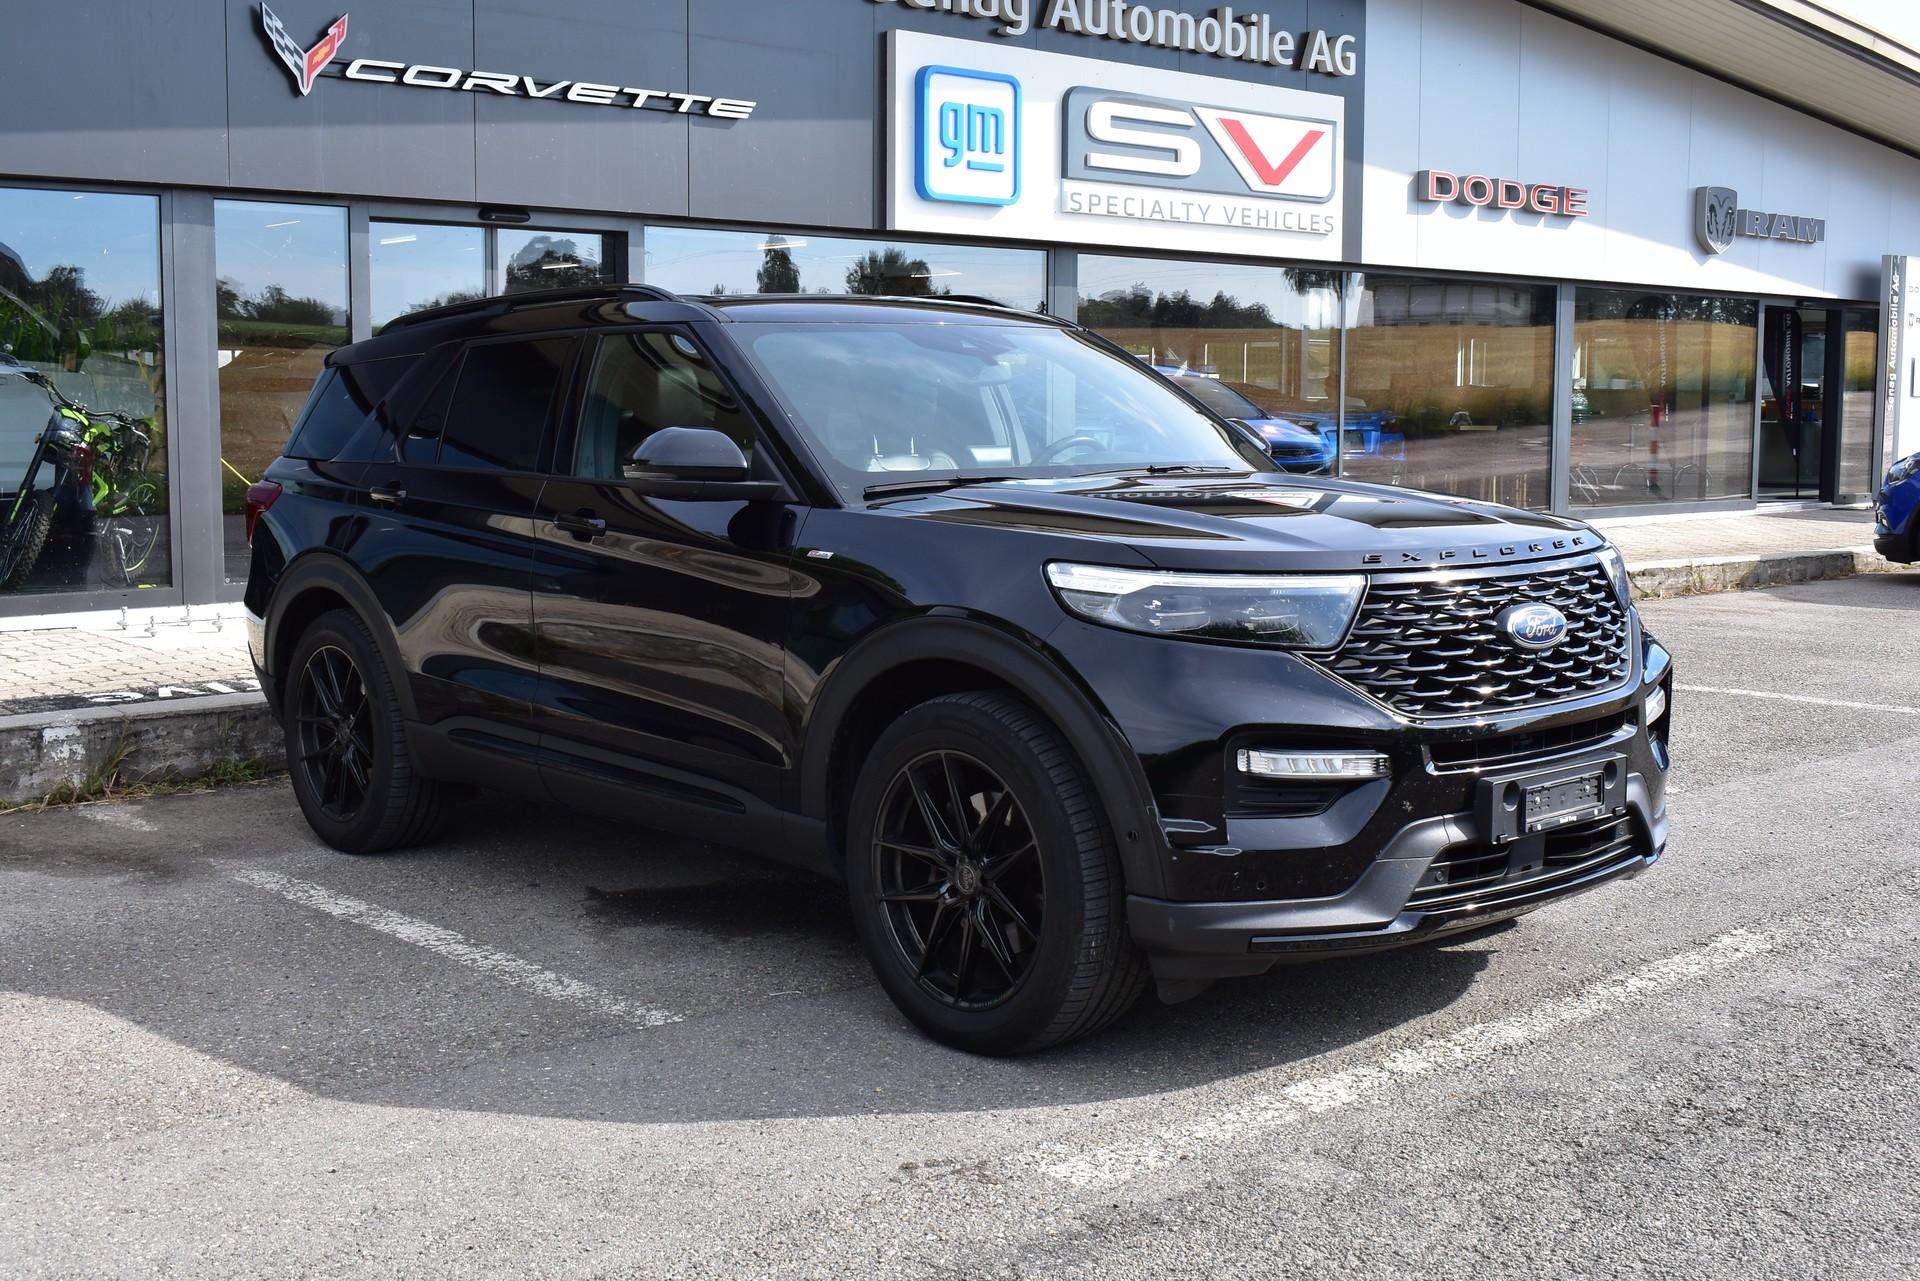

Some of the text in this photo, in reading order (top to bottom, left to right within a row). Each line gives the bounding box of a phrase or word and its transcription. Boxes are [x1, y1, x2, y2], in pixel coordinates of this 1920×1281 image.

[1046, 0, 1295, 66] Automobile
[1304, 29, 1357, 77] AG
[345, 58, 757, 120] CORVETTE
[939, 101, 1005, 168] gm
[1069, 191, 1335, 234] SPECIALTY VEHICLES
[1427, 170, 1589, 217] DODGE
[1744, 209, 1826, 244] RAM
[1362, 536, 1585, 564] EXPLORER
[1525, 613, 1558, 639] Ford
